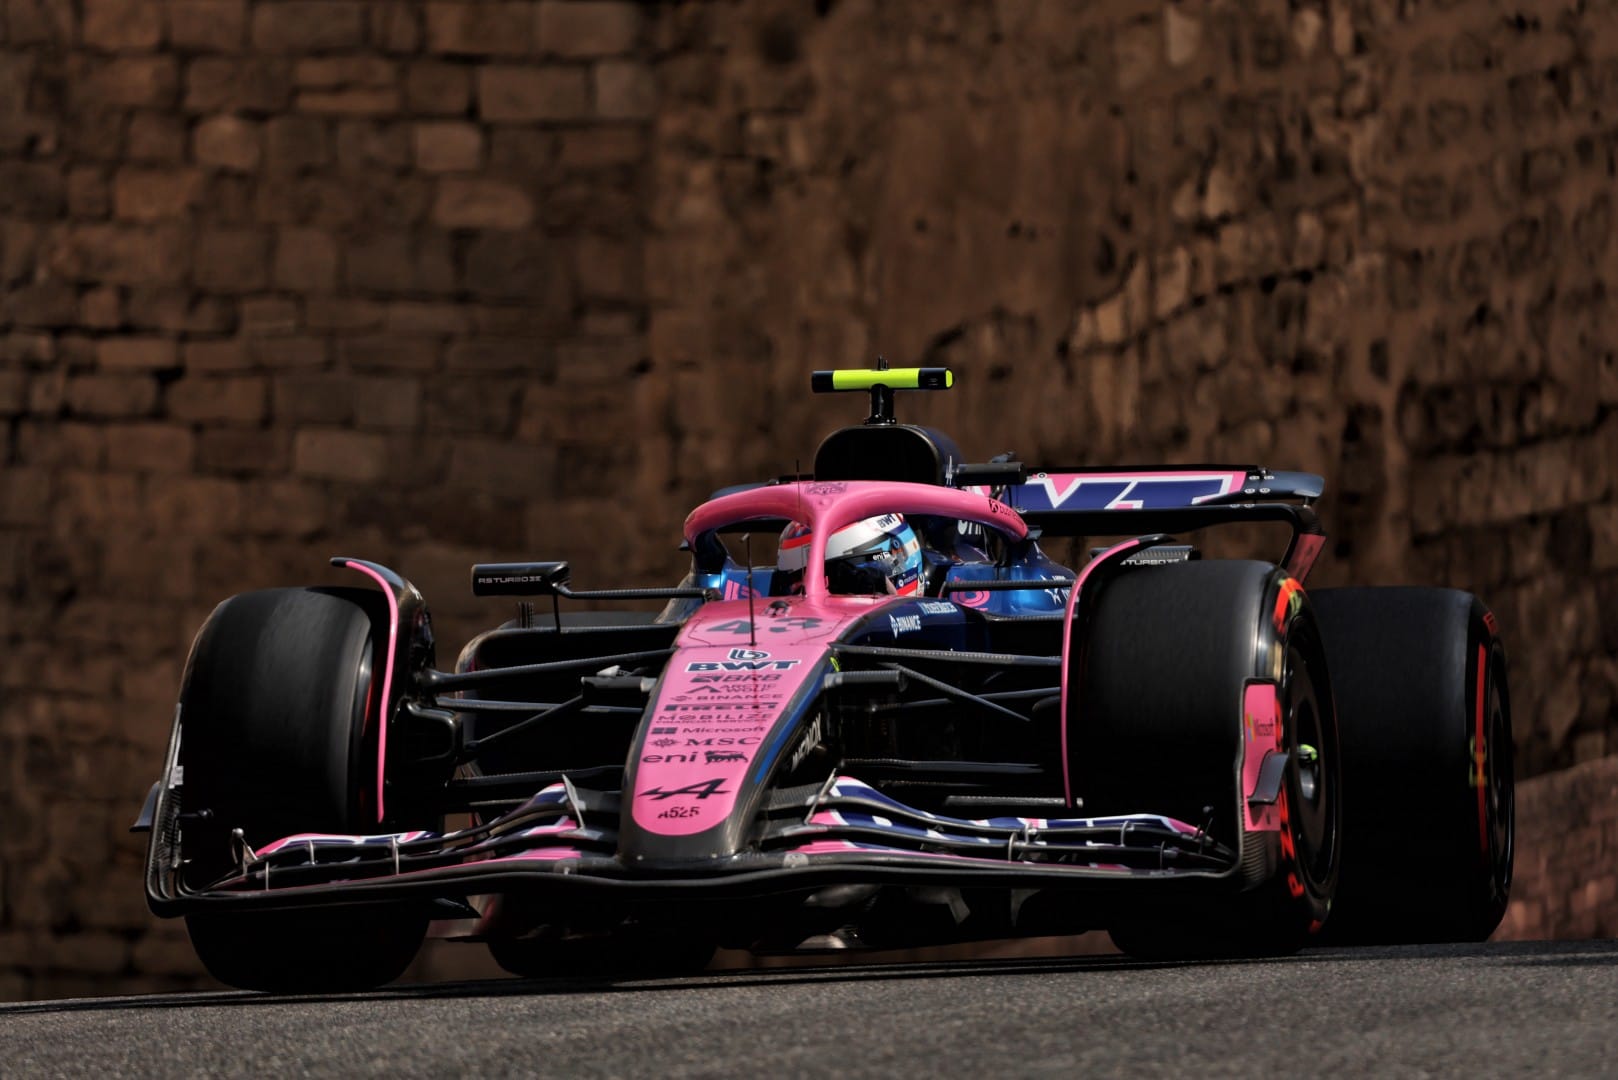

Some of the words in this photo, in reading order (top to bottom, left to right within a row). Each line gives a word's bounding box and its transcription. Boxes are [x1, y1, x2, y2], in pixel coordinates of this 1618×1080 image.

[706, 617, 823, 635] 43
[685, 660, 801, 672] BWT
[685, 737, 761, 746] MSC
[642, 752, 698, 763] eni
